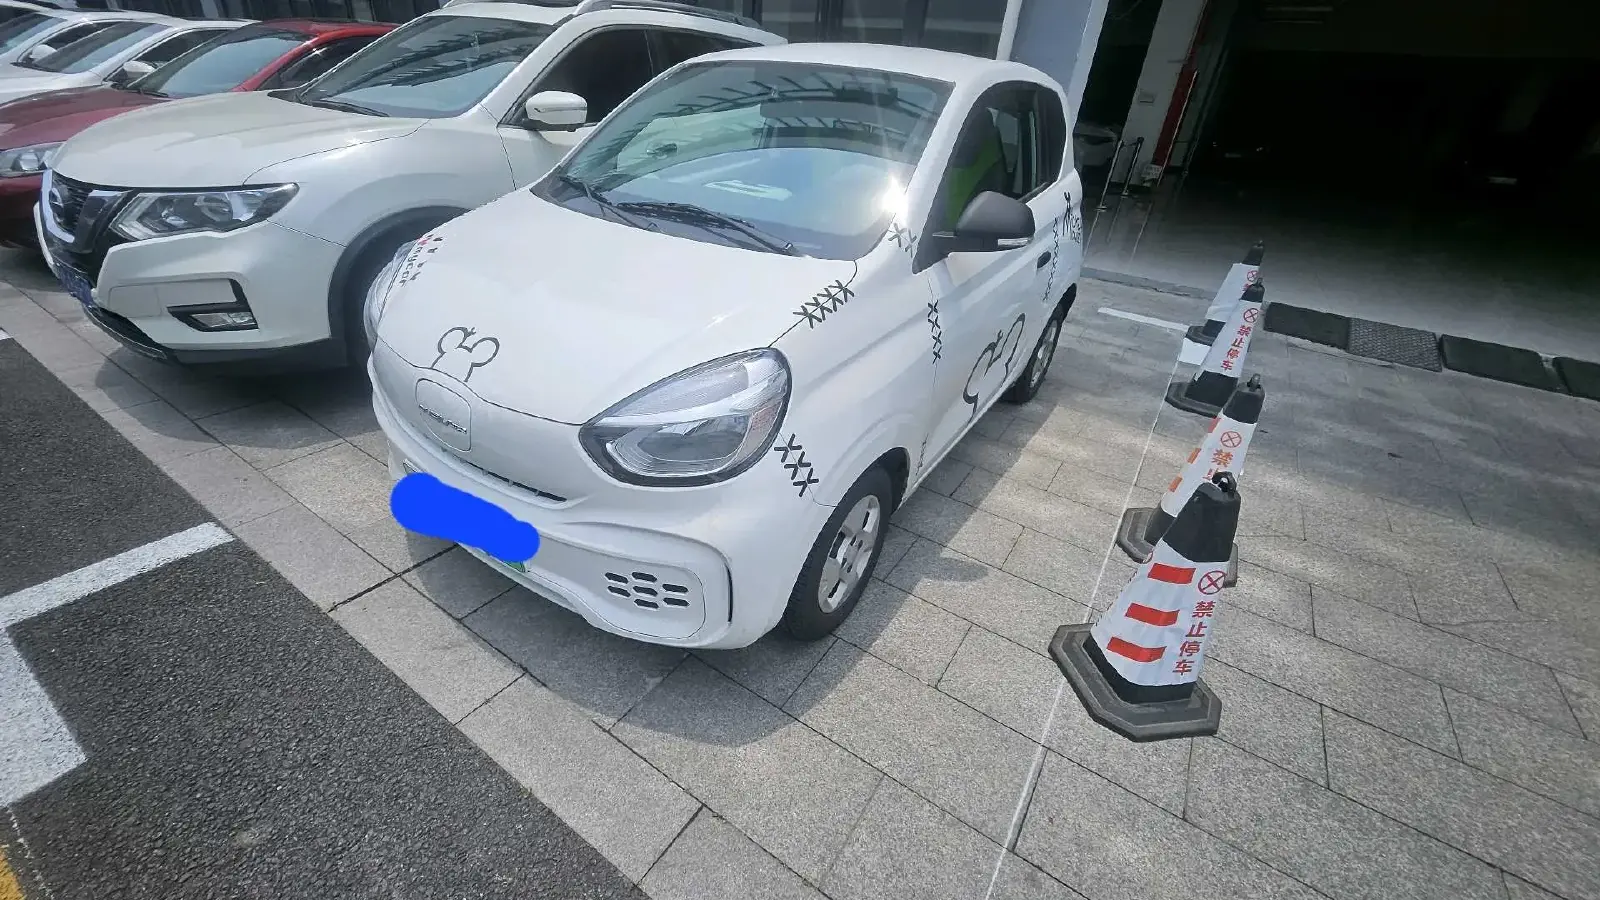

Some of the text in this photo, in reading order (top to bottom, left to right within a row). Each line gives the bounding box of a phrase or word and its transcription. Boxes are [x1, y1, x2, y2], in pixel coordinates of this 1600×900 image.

[1220, 325, 1252, 371] 禁止停车
[1172, 600, 1216, 676] 禁止停车
